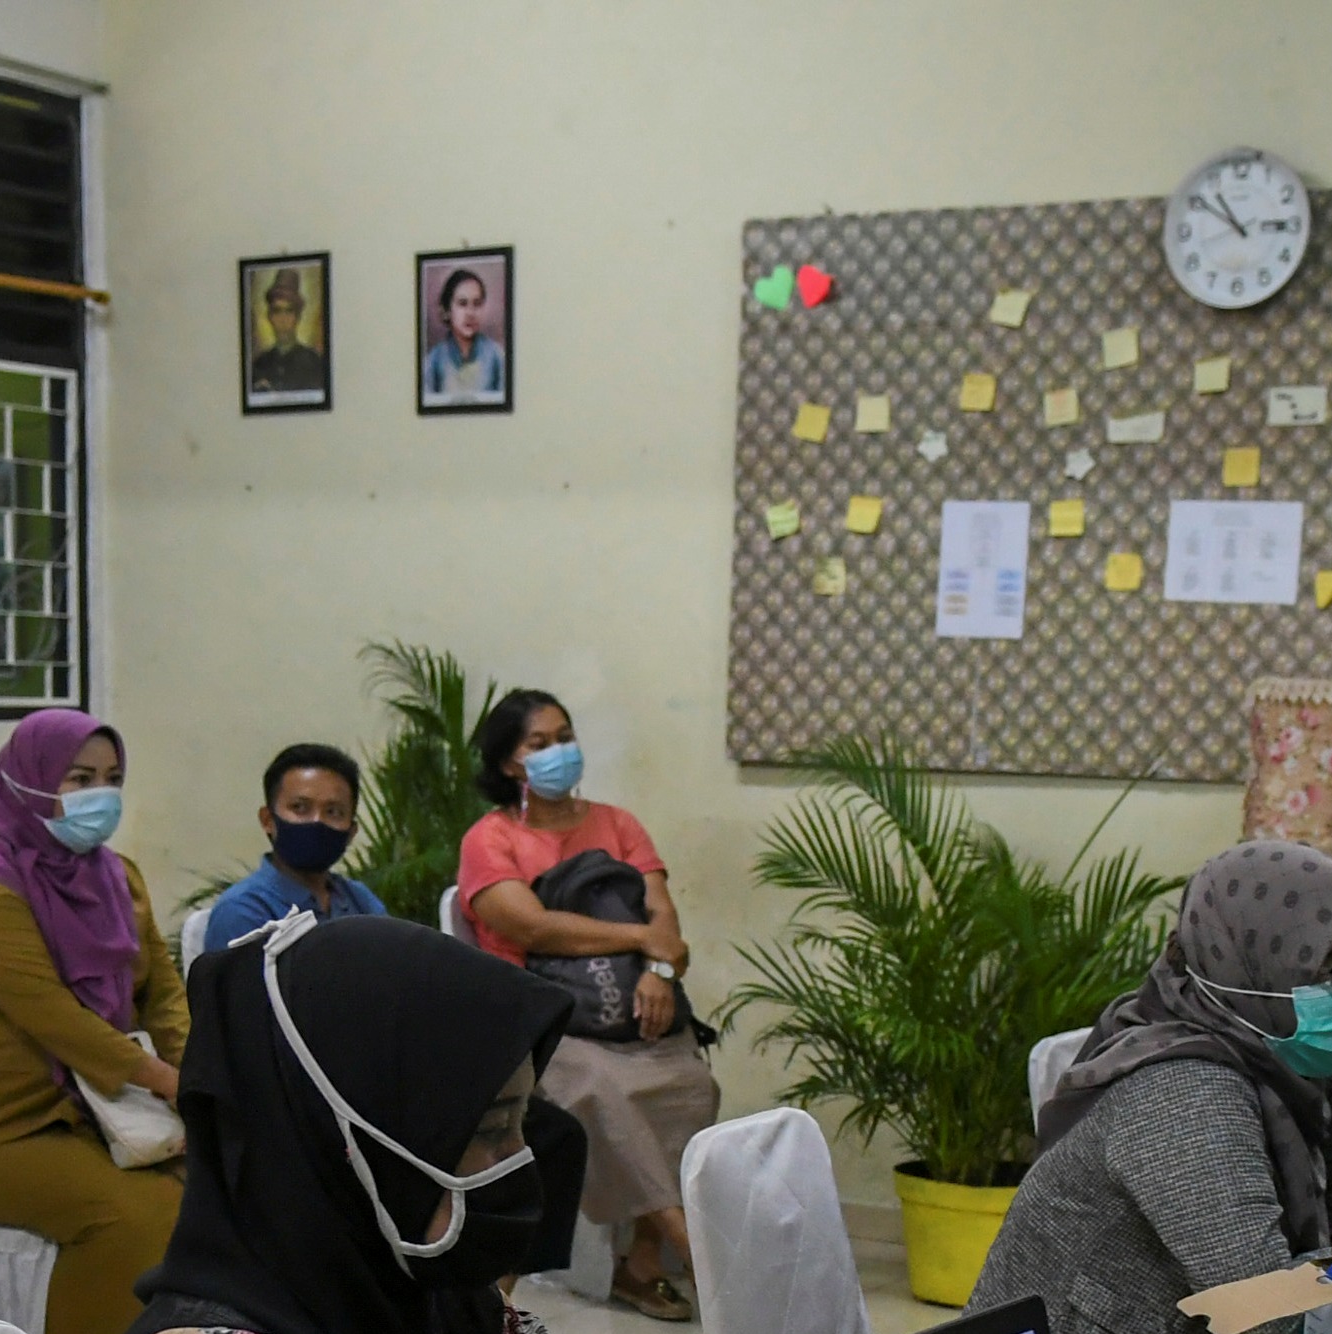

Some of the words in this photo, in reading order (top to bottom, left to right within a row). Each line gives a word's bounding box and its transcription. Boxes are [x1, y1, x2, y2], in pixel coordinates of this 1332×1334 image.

[1281, 184, 1295, 204] 2
[1207, 271, 1217, 288] 7
[1230, 277, 1244, 297] 6
